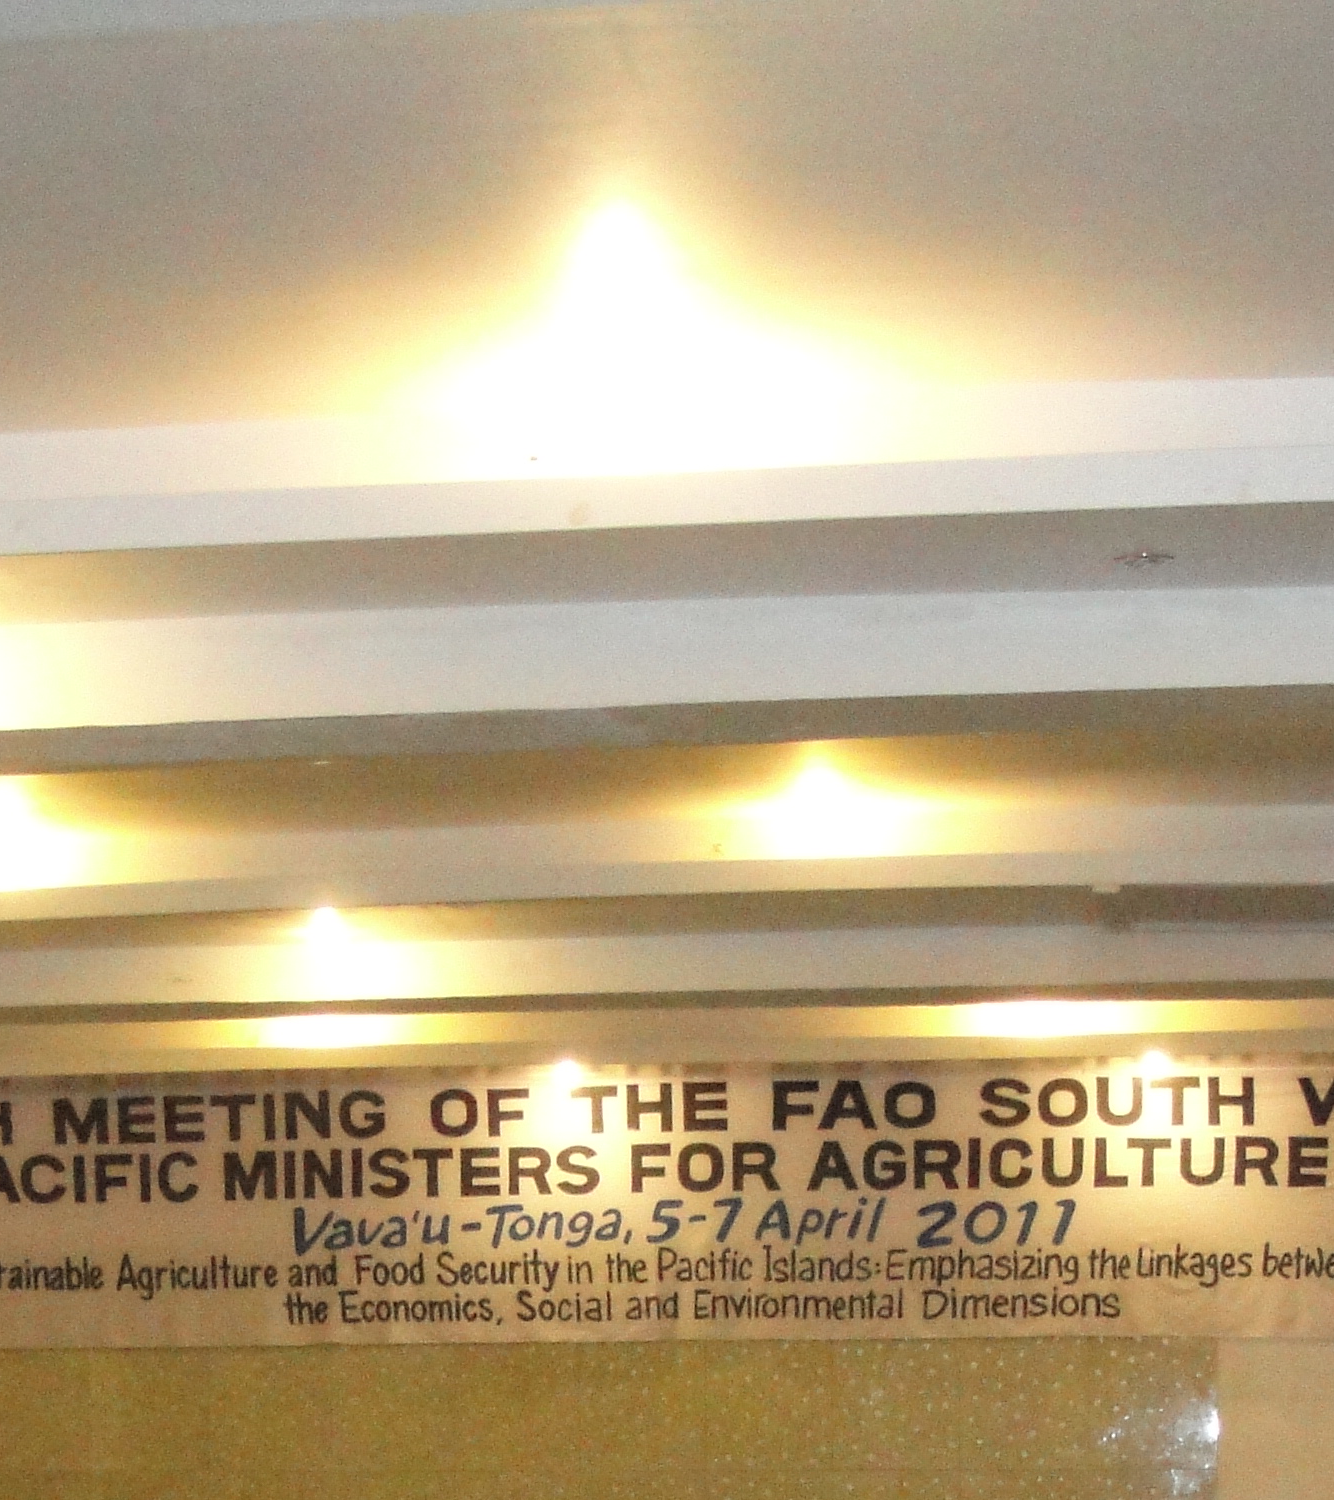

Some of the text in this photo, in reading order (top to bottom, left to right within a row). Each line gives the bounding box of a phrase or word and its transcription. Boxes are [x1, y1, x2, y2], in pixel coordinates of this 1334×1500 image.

[52, 1087, 386, 1146] MEETING
[429, 1087, 529, 1138] OF
[570, 1081, 728, 1134] THE
[772, 1079, 936, 1131] FAO
[978, 1076, 1255, 1128] SOUTH
[223, 1144, 601, 1201] MINISTERS
[630, 1141, 781, 1194] FOR
[806, 1136, 1330, 1192] AGRICULTURE
[646, 1197, 743, 1245] 5-7
[754, 1196, 887, 1247] April
[916, 1198, 1077, 1249] 2011
[116, 1252, 279, 1301] Agriculture
[287, 1254, 339, 1288] and
[354, 1252, 425, 1287] Food
[436, 1249, 560, 1291] Security
[567, 1253, 593, 1285] in
[606, 1248, 648, 1285] the
[657, 1246, 753, 1284] Pacific
[1088, 1247, 1131, 1280] the
[1136, 1243, 1252, 1288] Linkages
[283, 1286, 1122, 1327] the Economics, Social and Environmental Dimensions
